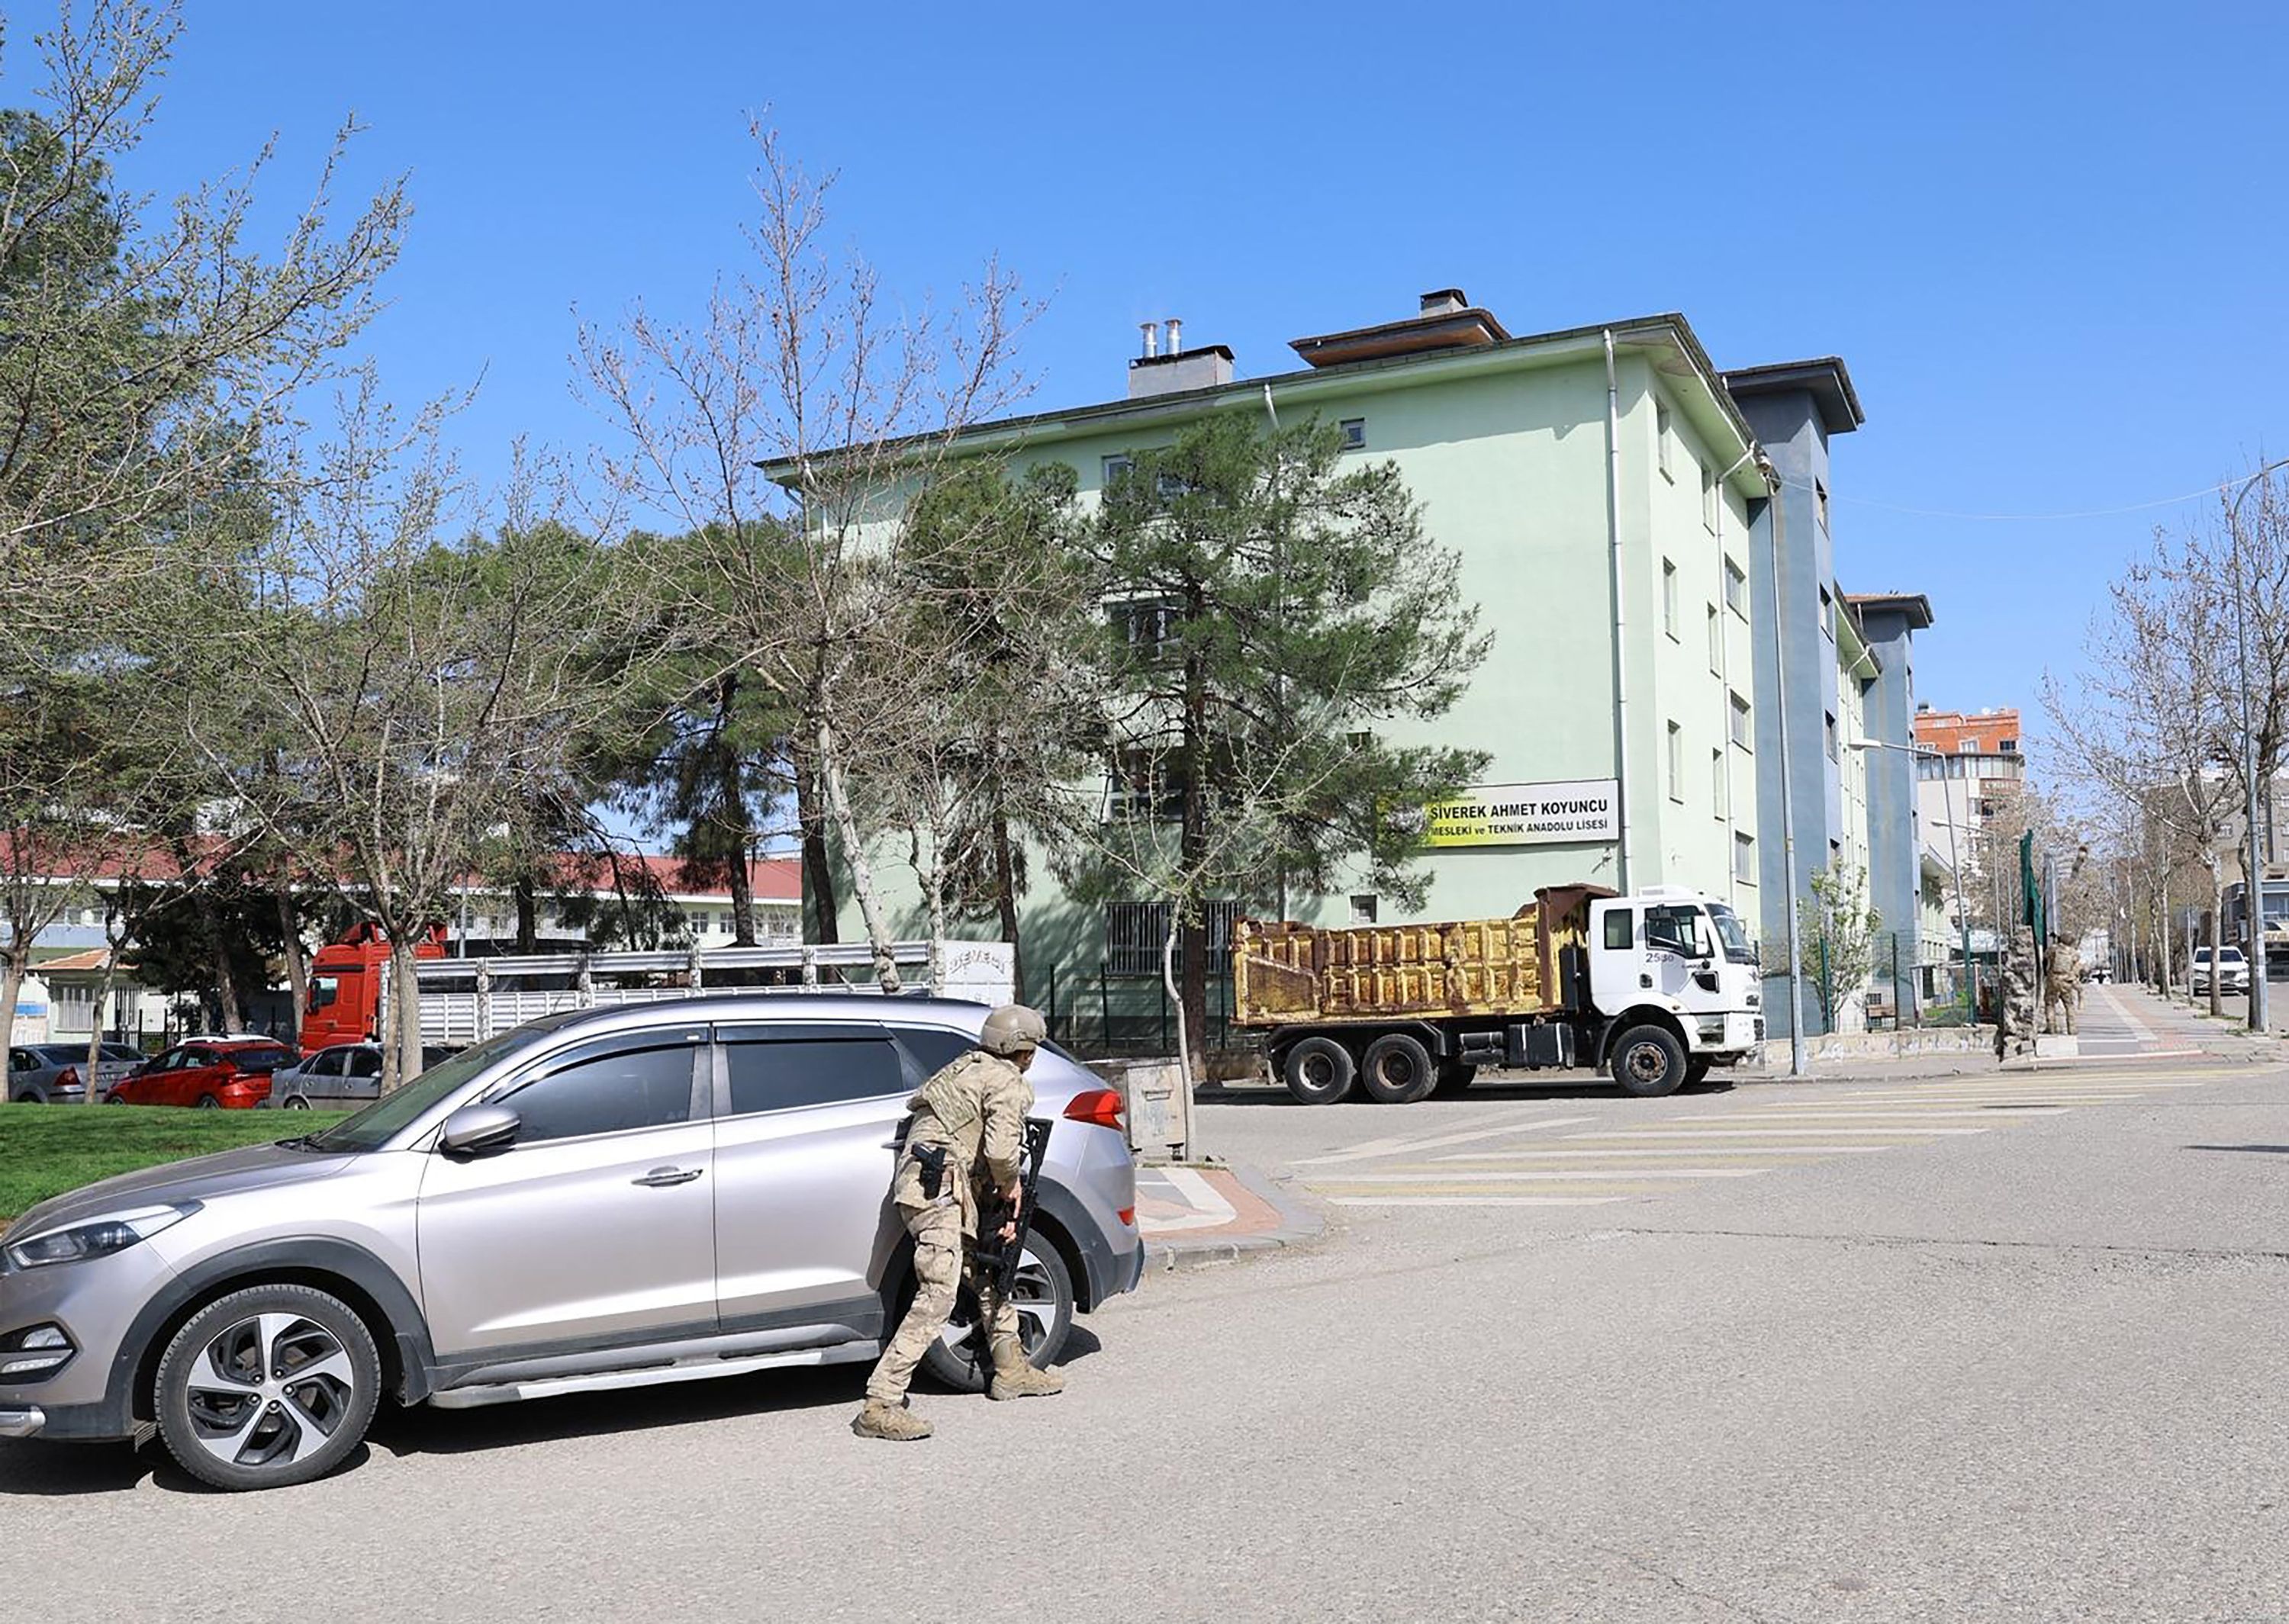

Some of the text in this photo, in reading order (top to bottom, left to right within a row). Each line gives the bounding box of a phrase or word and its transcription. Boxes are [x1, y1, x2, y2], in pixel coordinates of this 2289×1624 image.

[1431, 799, 1607, 819] SİVEREK AHMET KOYUNCU
[1488, 822, 1524, 835] TEKNİK
[1527, 821, 1573, 832] ANADOLU
[1576, 818, 1607, 830] LİSESİ
